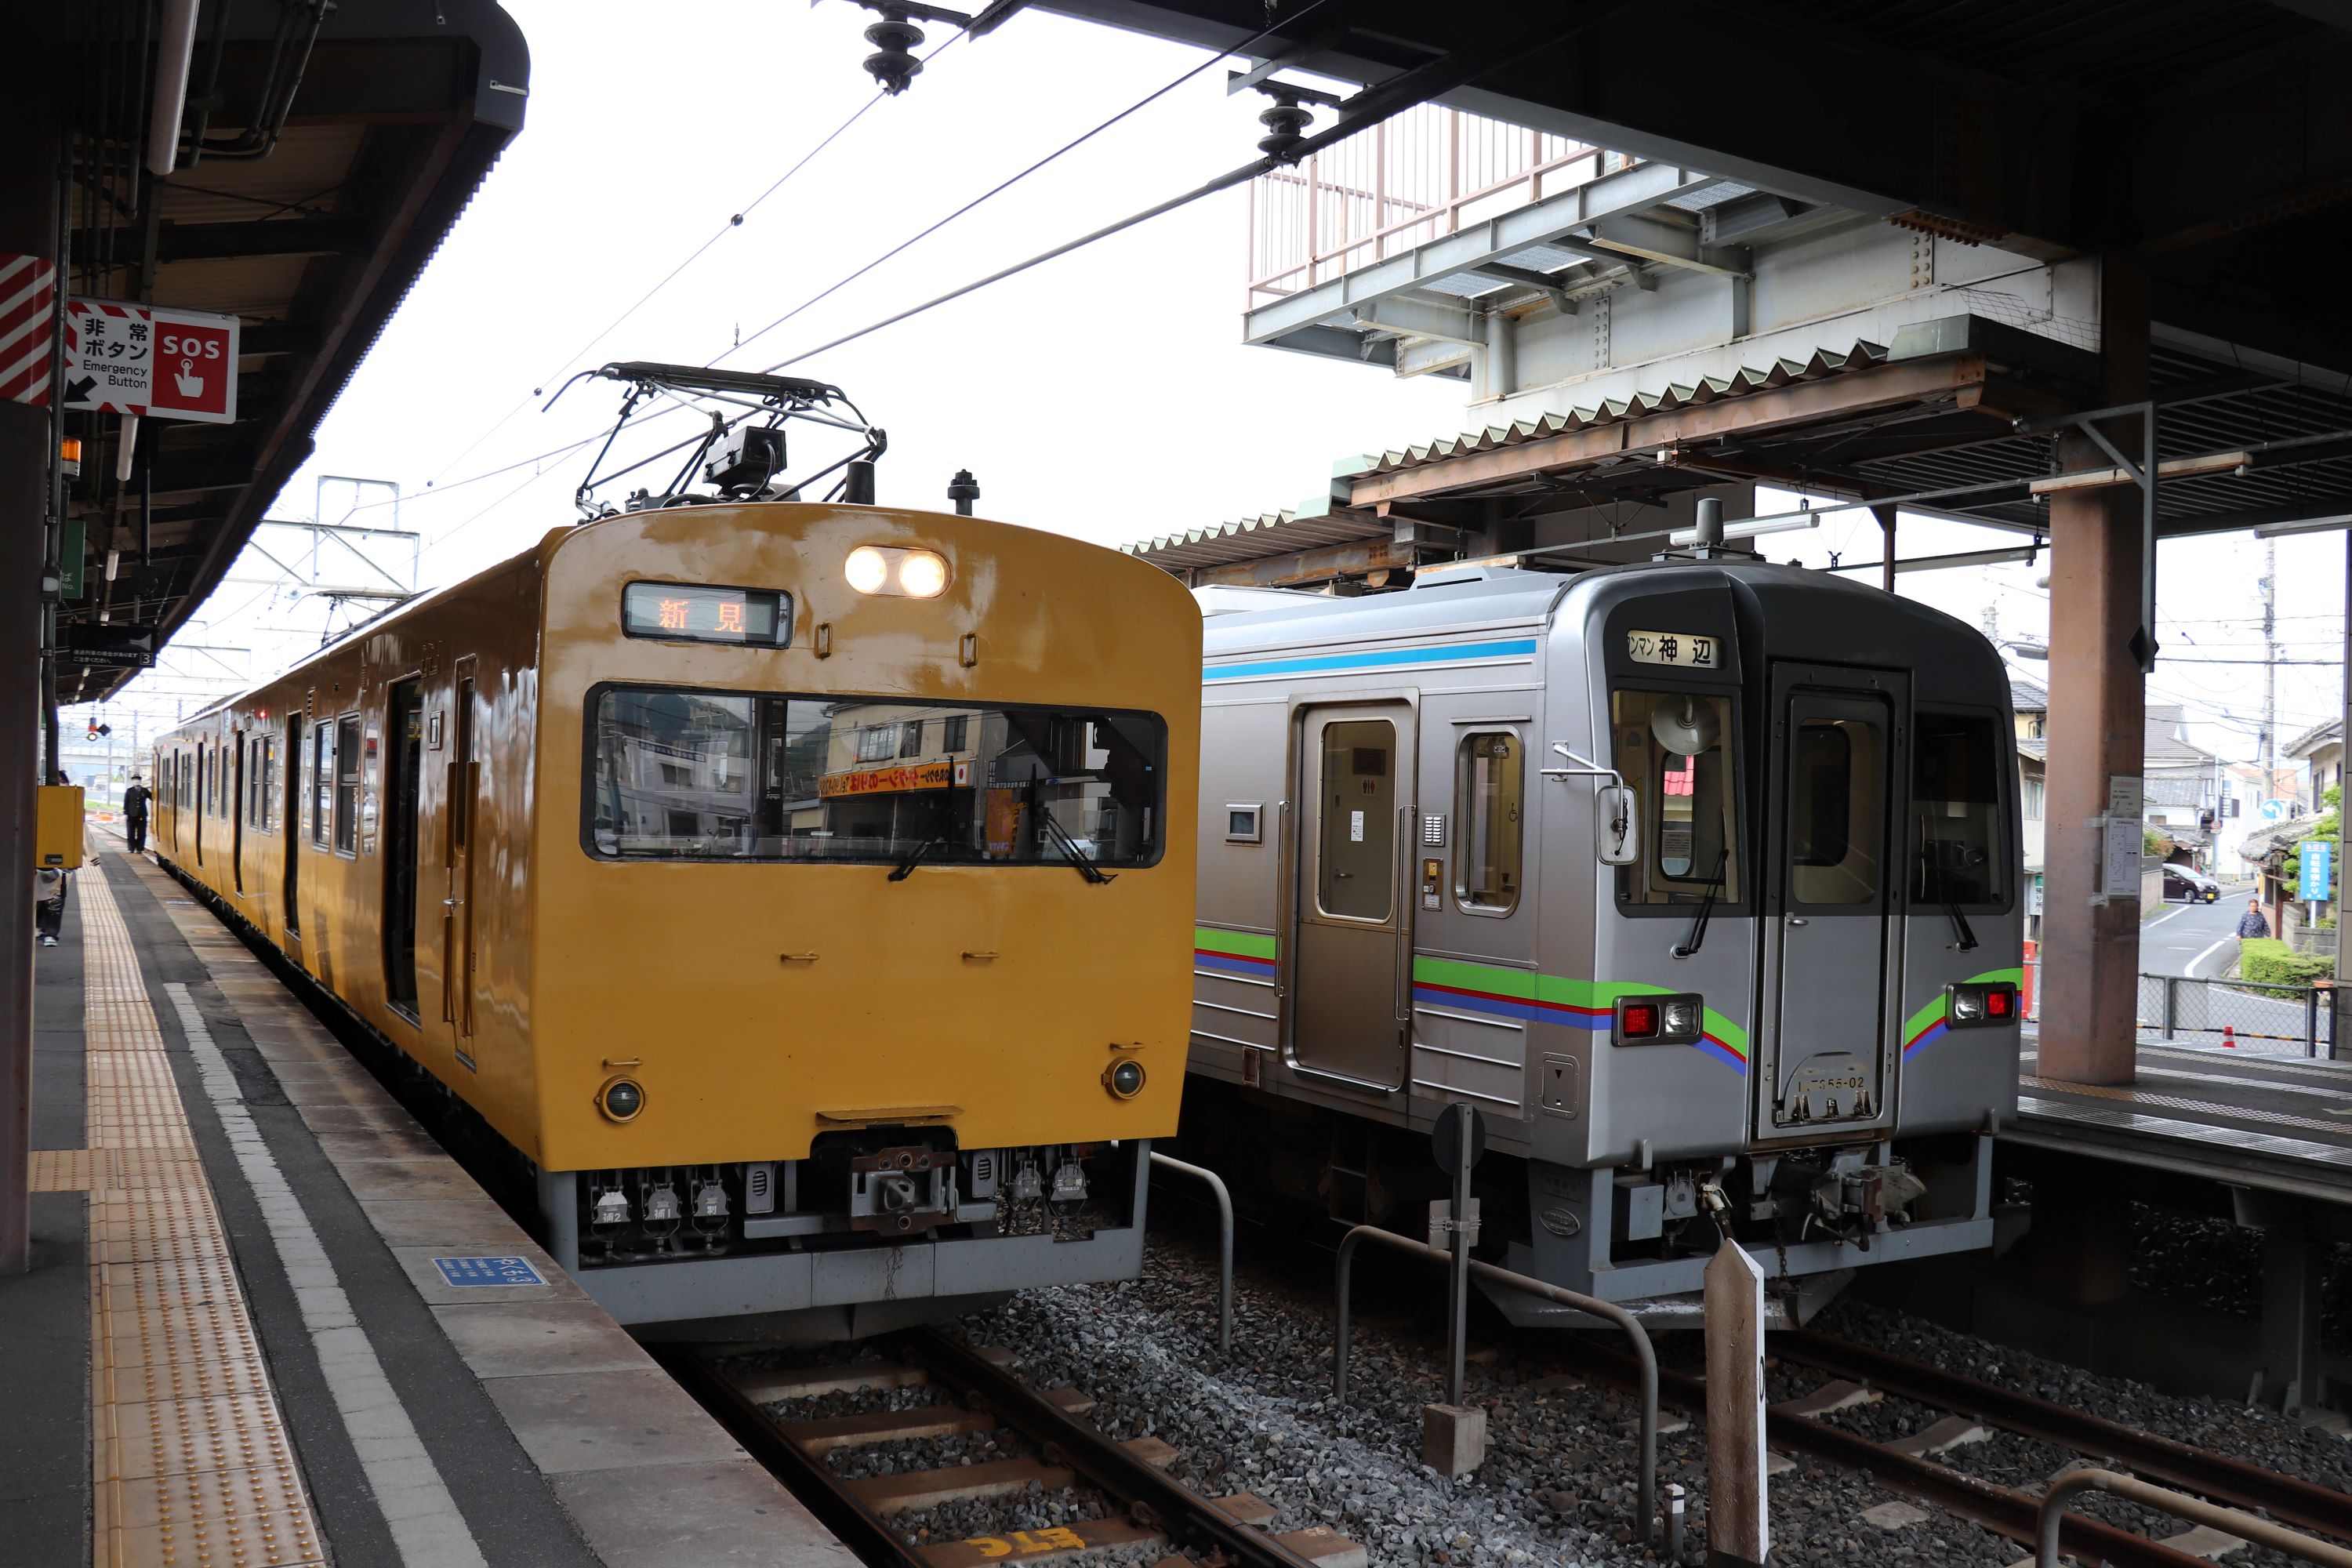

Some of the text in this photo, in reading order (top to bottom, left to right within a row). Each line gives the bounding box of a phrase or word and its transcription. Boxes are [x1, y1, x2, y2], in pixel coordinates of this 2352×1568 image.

[84, 318, 148, 342] 非常
[85, 339, 148, 361] ボタン
[162, 336, 220, 359] SOS
[83, 360, 147, 377] Emergency
[108, 375, 147, 389] Button
[659, 599, 743, 633] 新見
[142, 654, 151, 664] 3
[1628, 635, 1711, 665] ンマン 神辺
